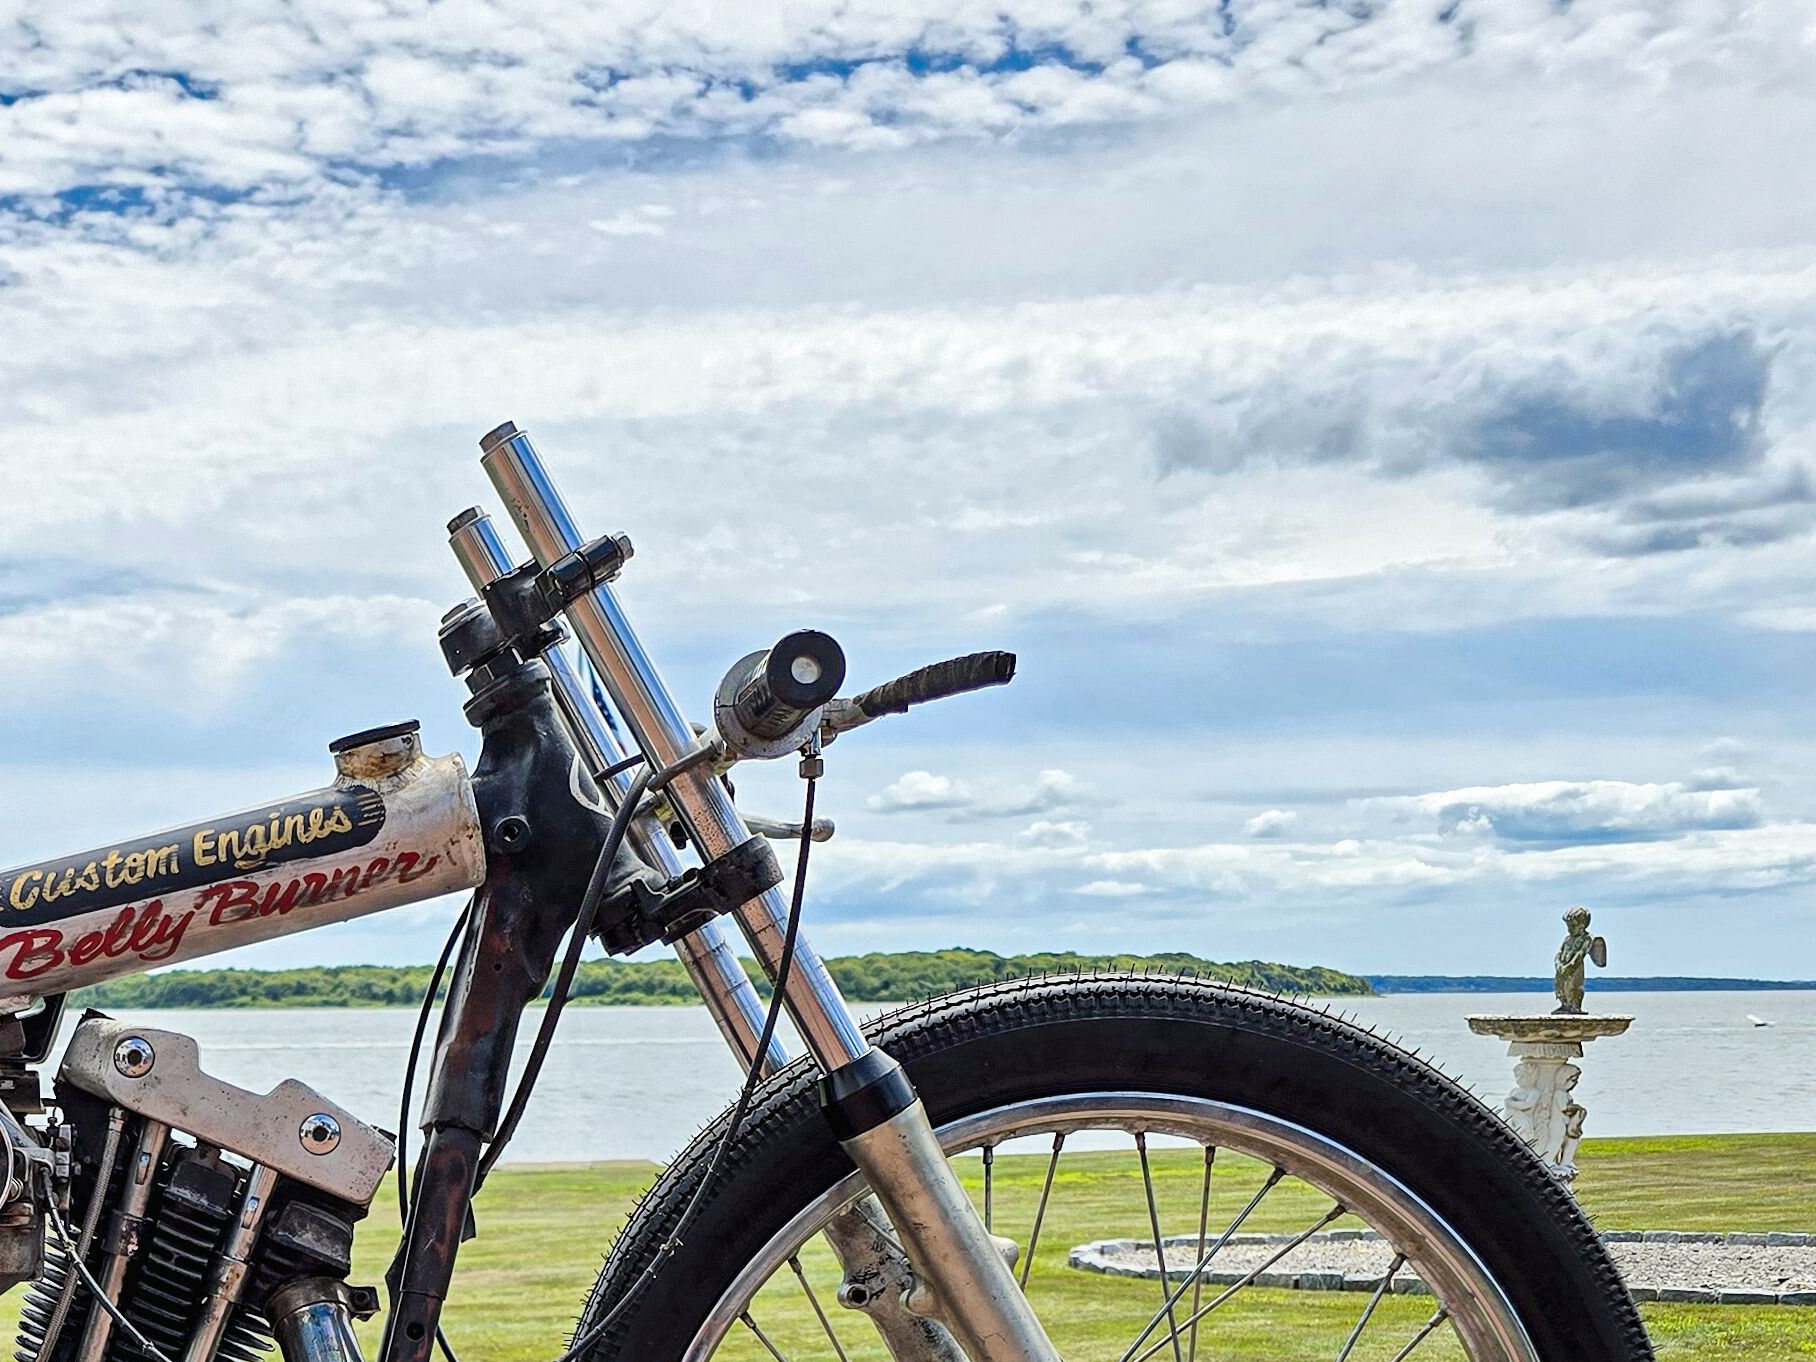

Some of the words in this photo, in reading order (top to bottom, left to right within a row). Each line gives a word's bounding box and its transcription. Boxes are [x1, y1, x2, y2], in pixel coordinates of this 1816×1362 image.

[9, 843, 181, 911] Custom
[193, 805, 354, 870] Engines
[192, 851, 439, 926] Burner
